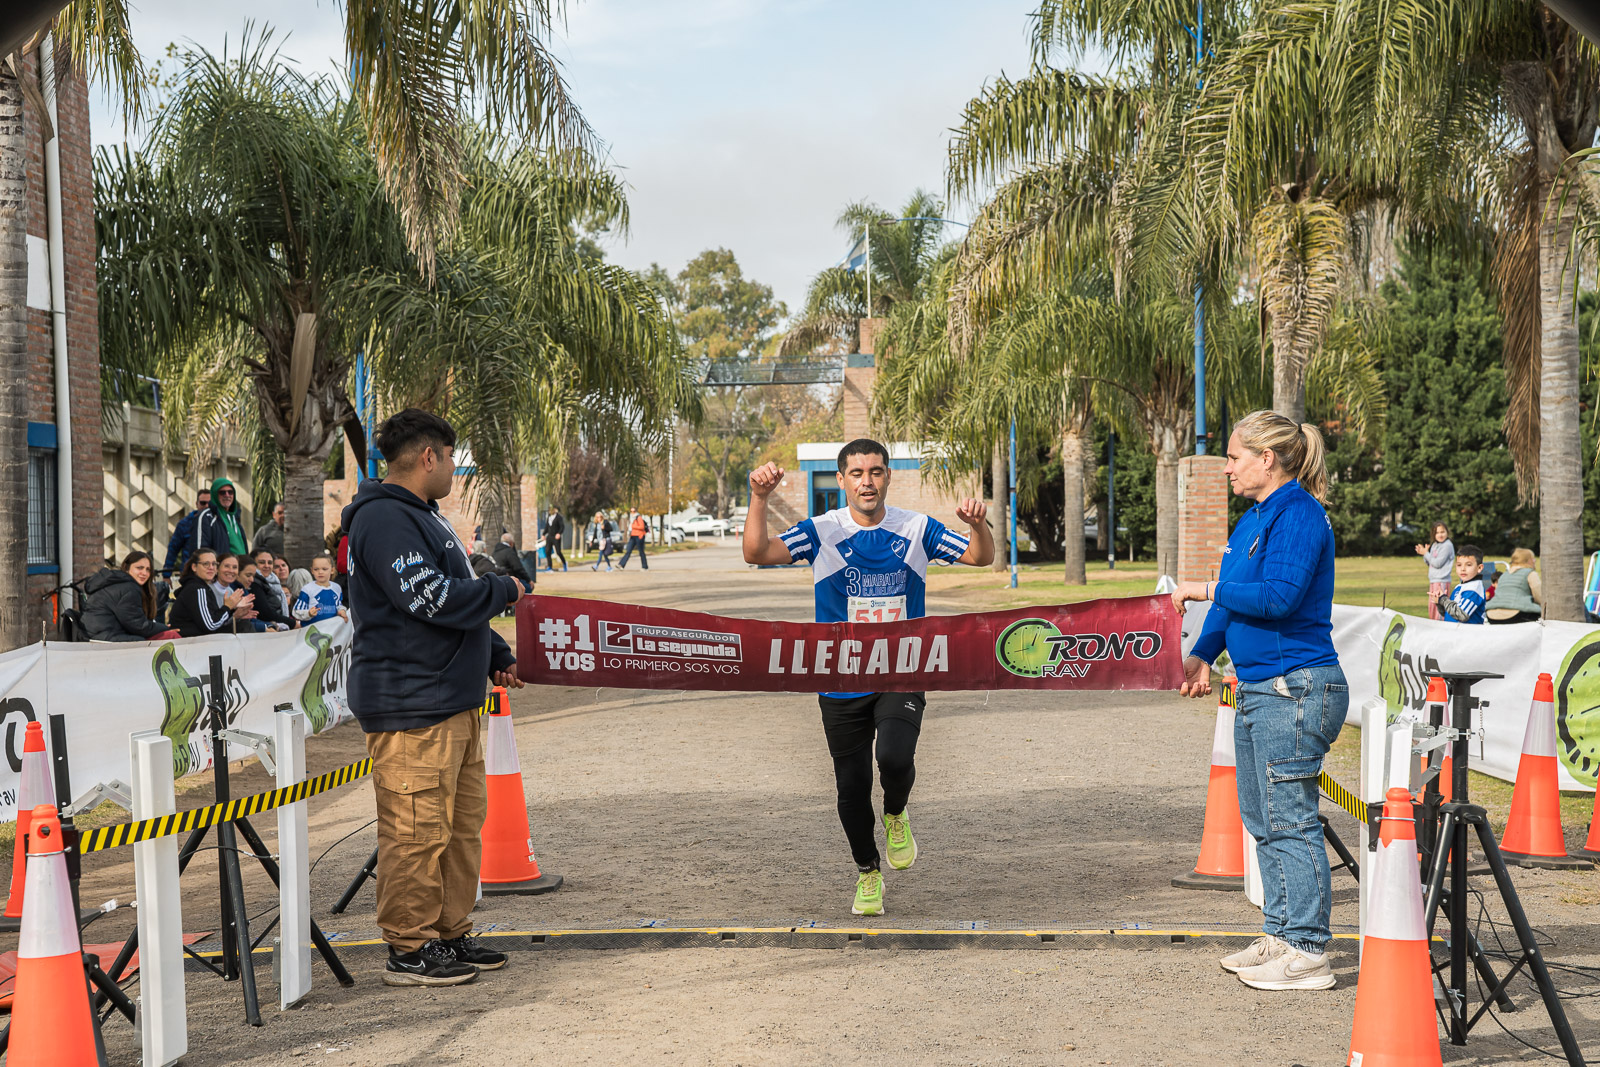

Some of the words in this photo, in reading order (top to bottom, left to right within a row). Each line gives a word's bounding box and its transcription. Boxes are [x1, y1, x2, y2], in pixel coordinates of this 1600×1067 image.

[392, 554, 406, 574] El
[408, 566, 435, 593] pueblo
[844, 566, 862, 597] 3
[862, 569, 907, 588] MARATÓN
[855, 608, 902, 623] 517
[538, 614, 595, 651] #1
[636, 627, 669, 637] GRUPO
[670, 630, 736, 643] ASEGURADOR
[658, 640, 737, 657] segunda
[768, 634, 949, 675] LLEGADA
[545, 651, 596, 672] VOS
[603, 657, 622, 669] LO
[625, 659, 681, 672] PRIMERO
[684, 663, 710, 674] SOS
[713, 664, 740, 675] VOS
[1041, 663, 1092, 678] RAV
